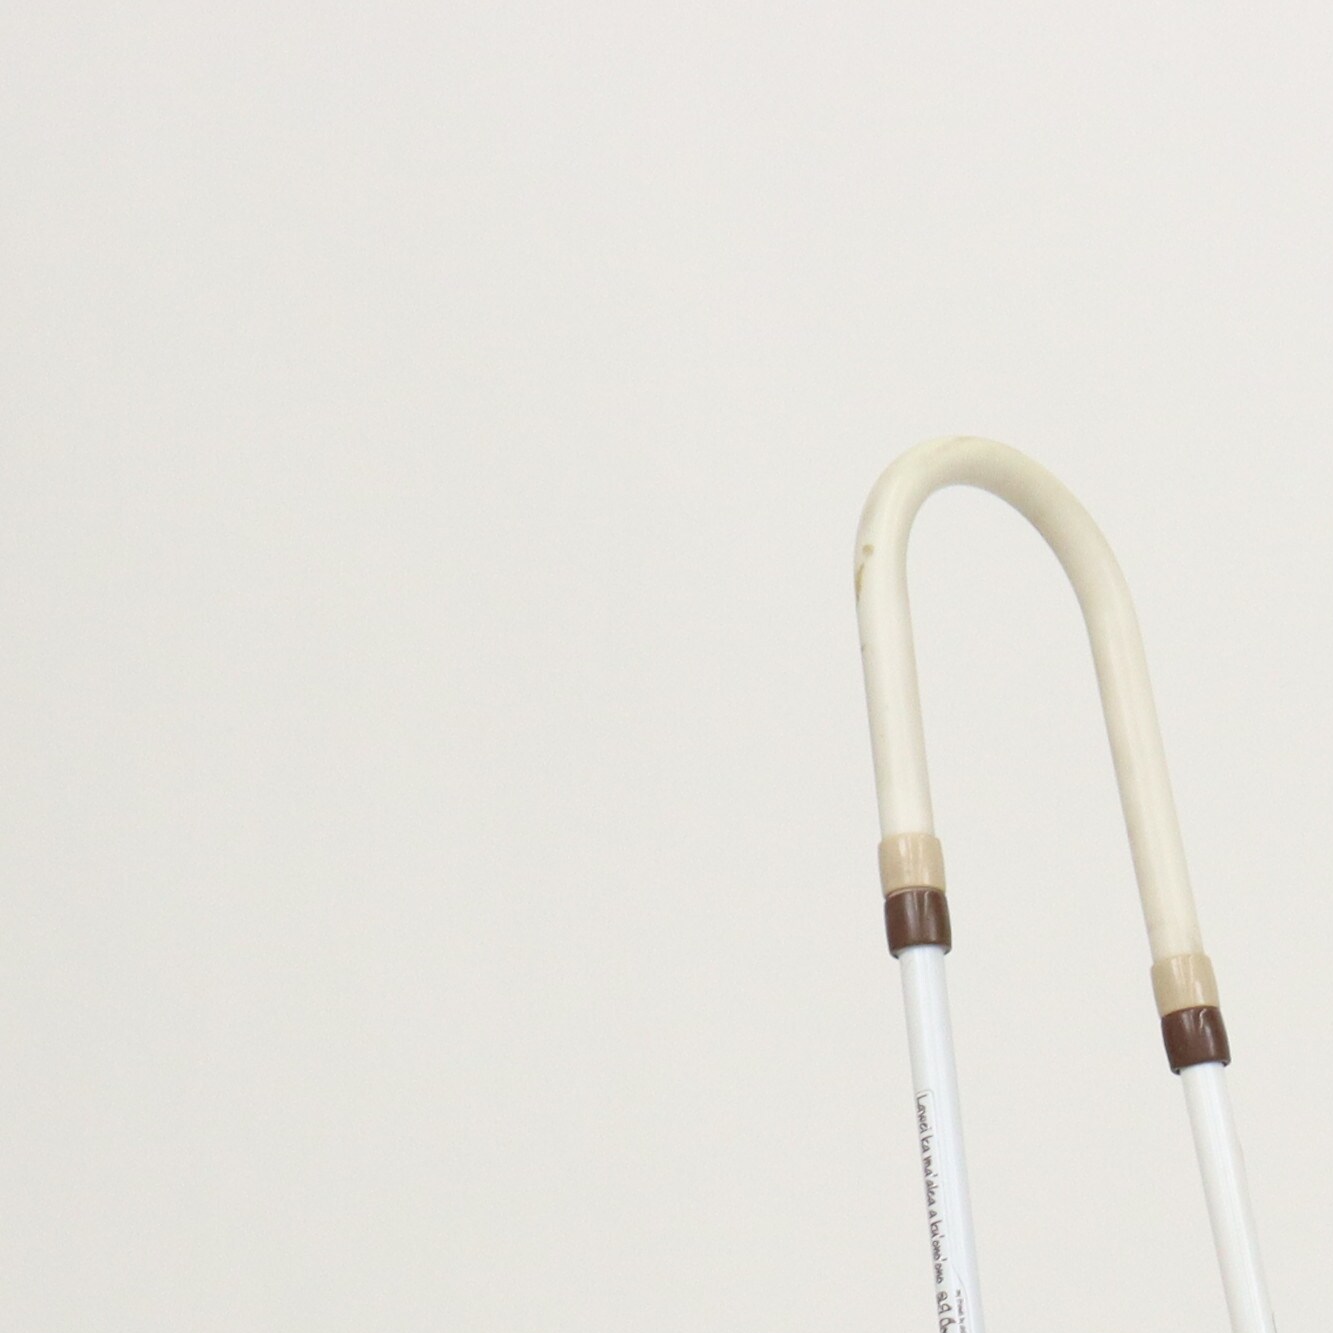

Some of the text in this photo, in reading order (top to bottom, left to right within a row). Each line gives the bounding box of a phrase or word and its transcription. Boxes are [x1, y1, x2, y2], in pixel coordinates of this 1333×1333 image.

[916, 1094, 932, 1134] Lawei
[921, 1135, 933, 1153] ka
[929, 1209, 938, 1219] a
